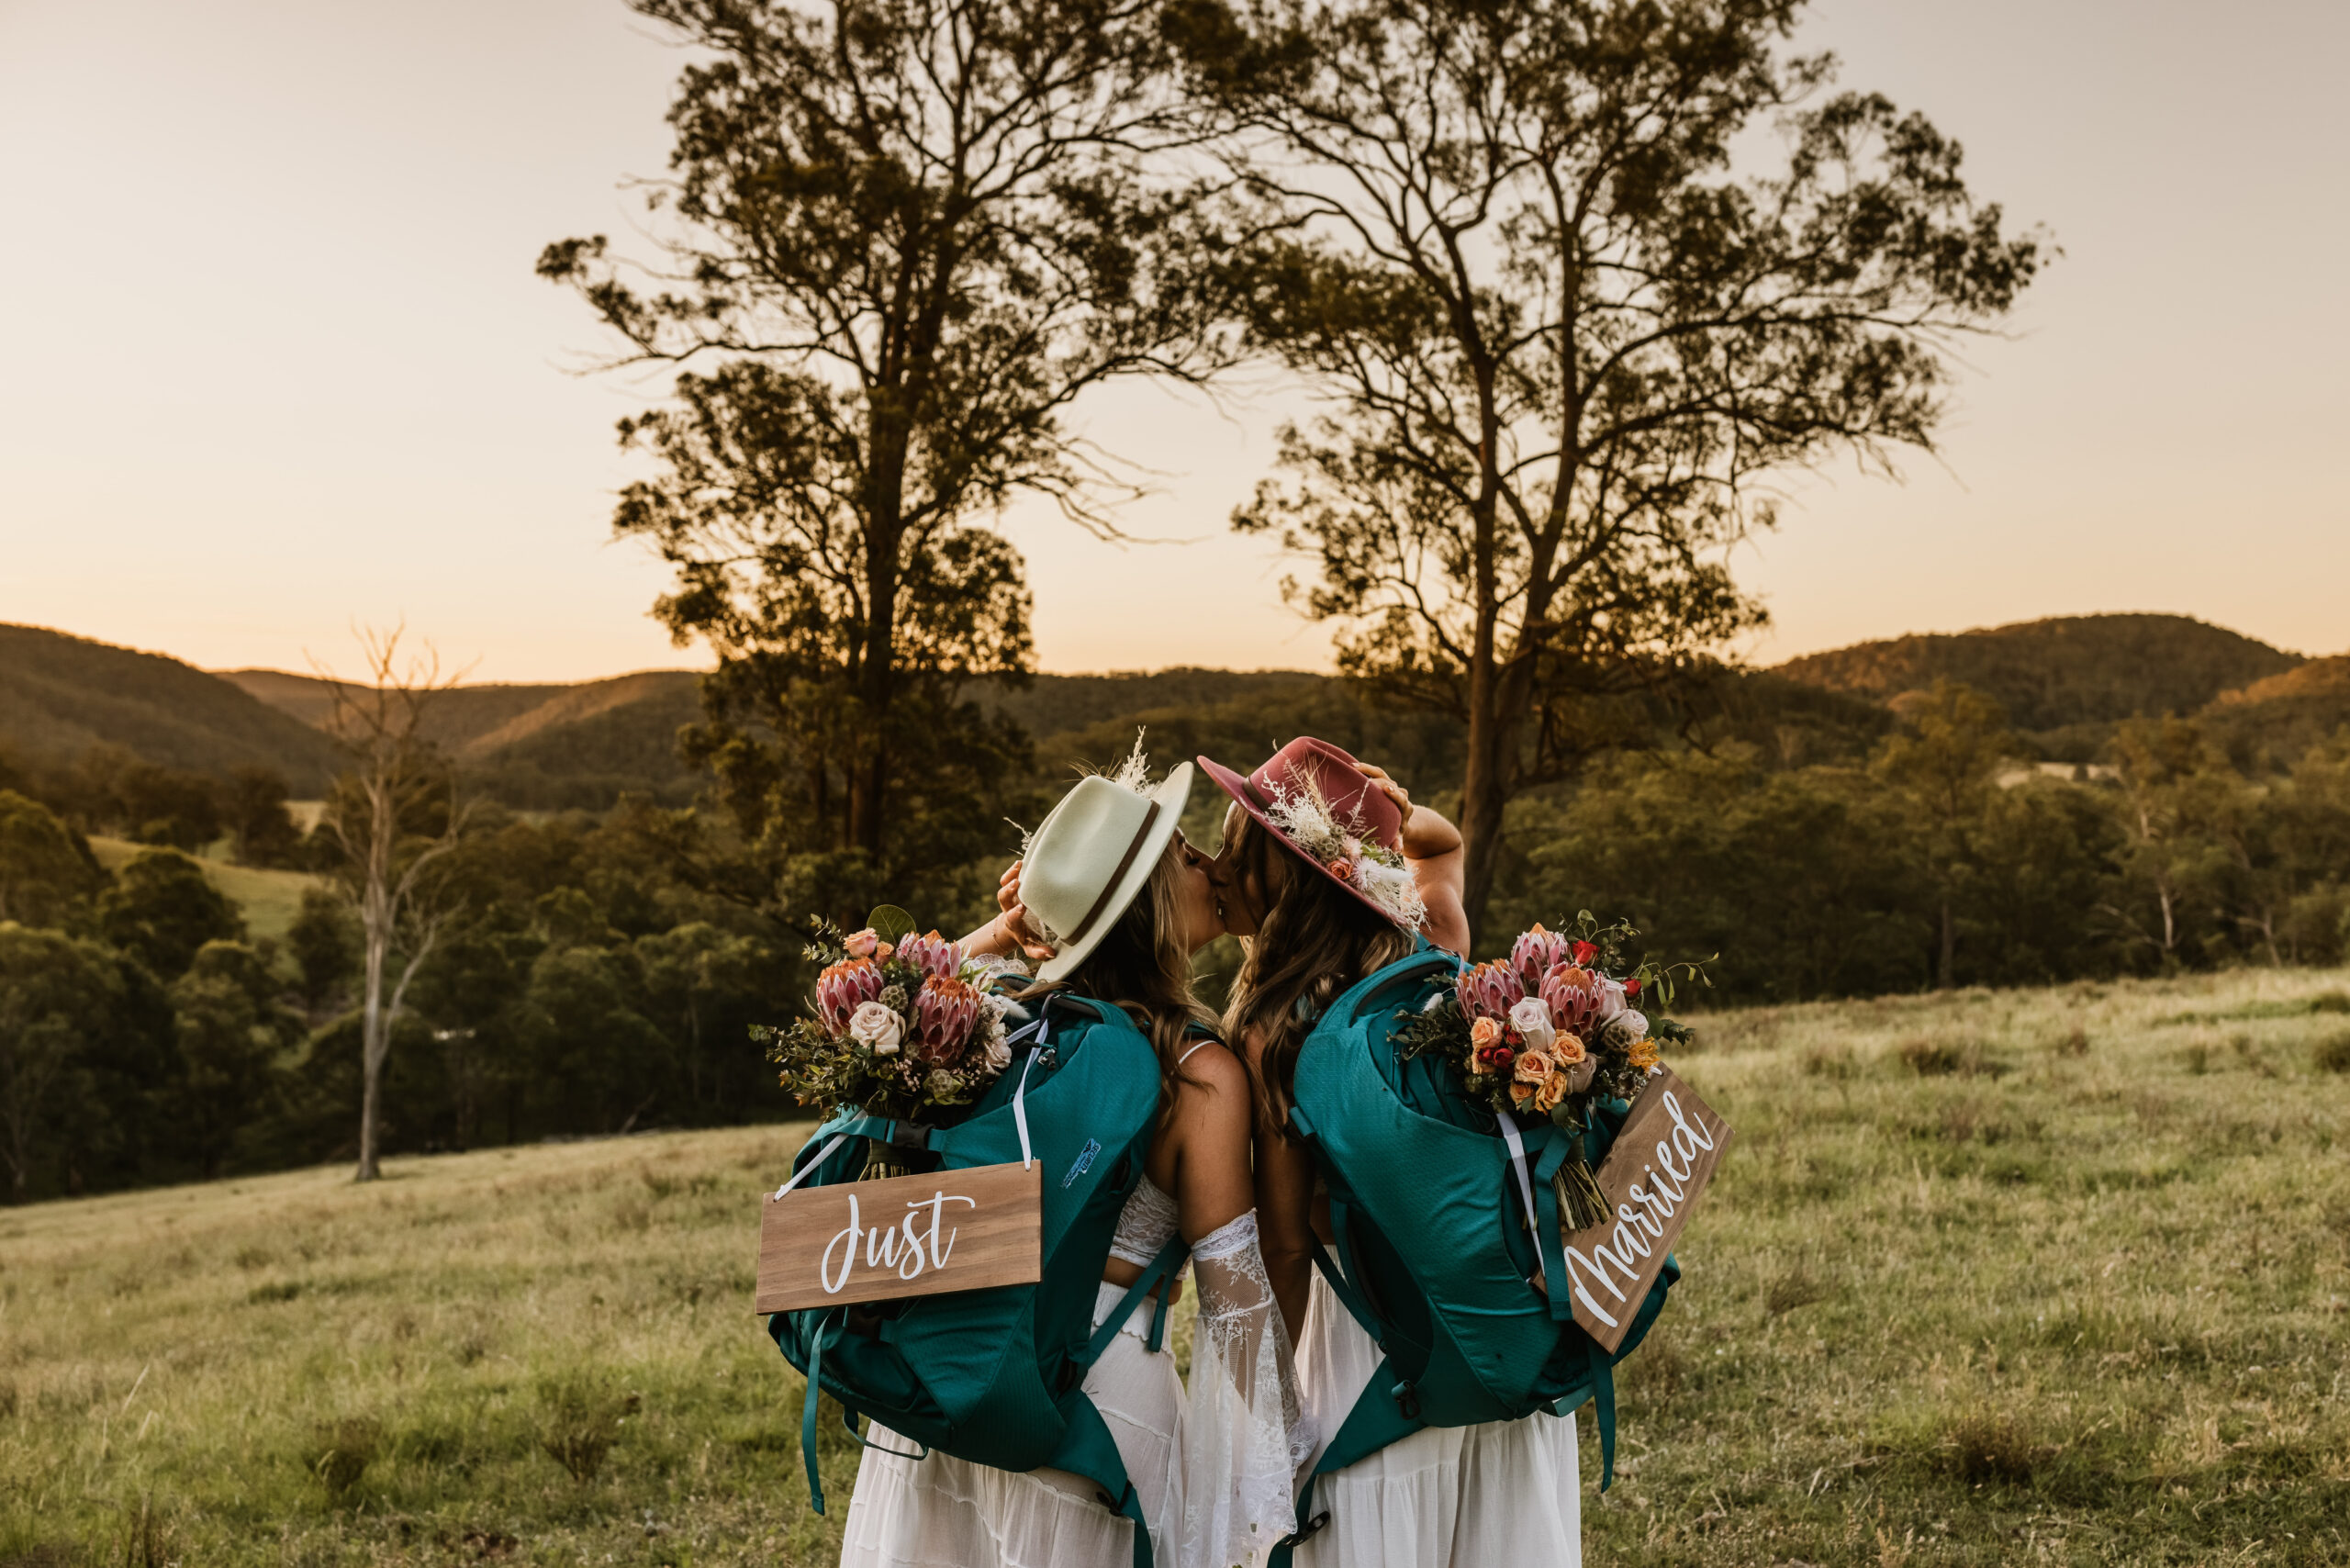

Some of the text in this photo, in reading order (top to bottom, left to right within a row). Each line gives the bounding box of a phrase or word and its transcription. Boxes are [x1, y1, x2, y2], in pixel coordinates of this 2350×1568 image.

[1080, 1142, 1101, 1171] SECURITY
[821, 1191, 976, 1294] Just
[1563, 1090, 1714, 1328] Married
